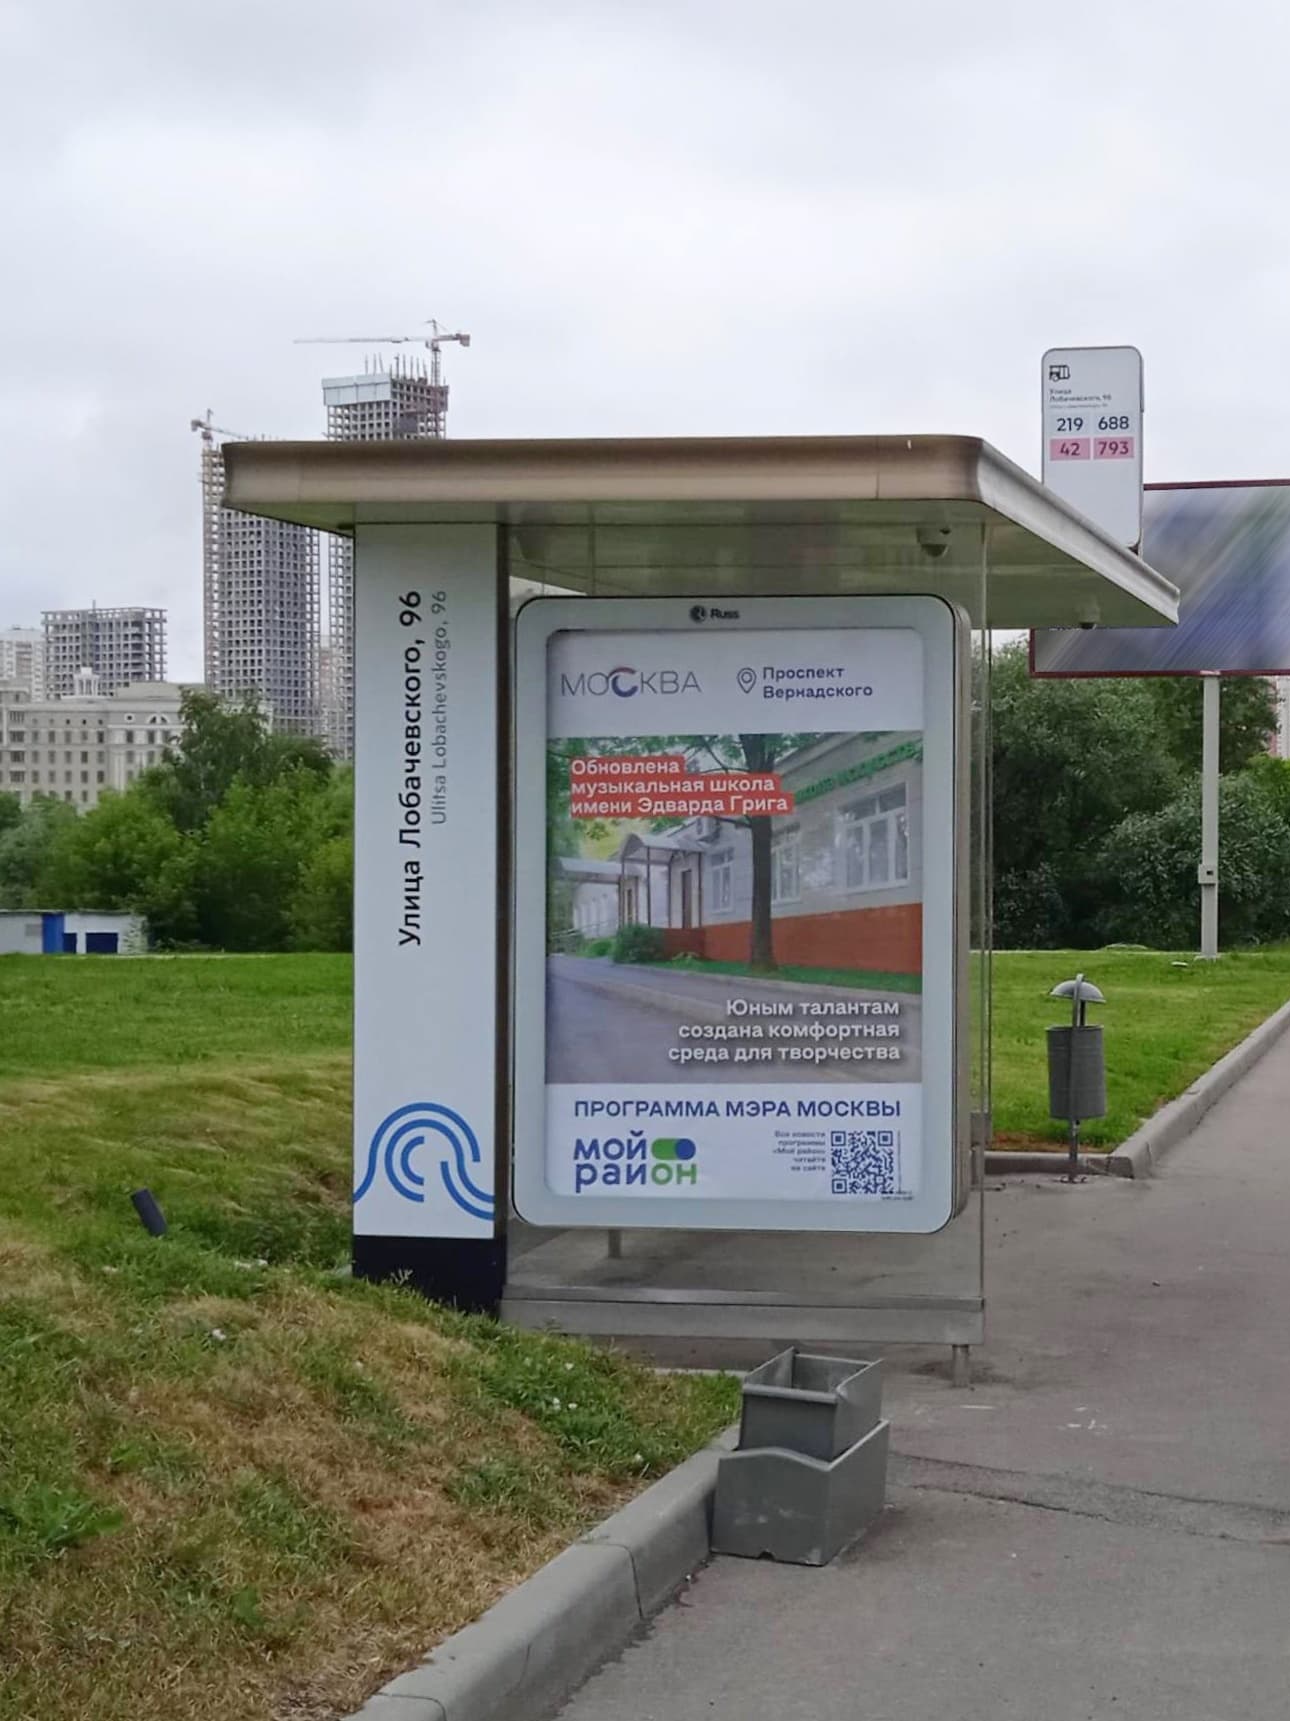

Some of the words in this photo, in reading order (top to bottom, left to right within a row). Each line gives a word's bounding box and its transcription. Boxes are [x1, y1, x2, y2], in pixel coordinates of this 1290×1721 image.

[1057, 417, 1083, 432] 219
[1098, 416, 1130, 431] 688
[1060, 442, 1080, 456] 42
[1098, 441, 1129, 456] 793
[398, 591, 422, 627] 96
[431, 591, 446, 614] 96
[710, 608, 740, 619] Russ
[561, 667, 702, 698] МОСКВА
[763, 666, 845, 682] Проспект
[431, 620, 451, 769] Lobachevskogo,
[763, 685, 873, 702] Вернадского
[399, 639, 425, 848] Лобачевского,
[571, 759, 680, 775] Обновлена
[571, 779, 705, 797] музыкальная
[710, 778, 775, 792] школа
[431, 775, 446, 825] Ulitsa
[571, 800, 632, 813] имени
[638, 797, 725, 816] Эдварда
[730, 795, 788, 815] Грига
[399, 861, 424, 946] Улица
[726, 999, 794, 1016] Юным
[800, 1001, 899, 1015] талантам
[679, 1024, 763, 1039] создана
[768, 1021, 900, 1041] комфортная
[668, 1047, 729, 1064] среда
[734, 1047, 772, 1061] для
[778, 1046, 900, 1064] творчества
[574, 1100, 720, 1117] ПРОГРАММА
[725, 1100, 791, 1117] МЭРА
[797, 1100, 901, 1117] МОСКВЫ
[573, 1130, 647, 1160] мой
